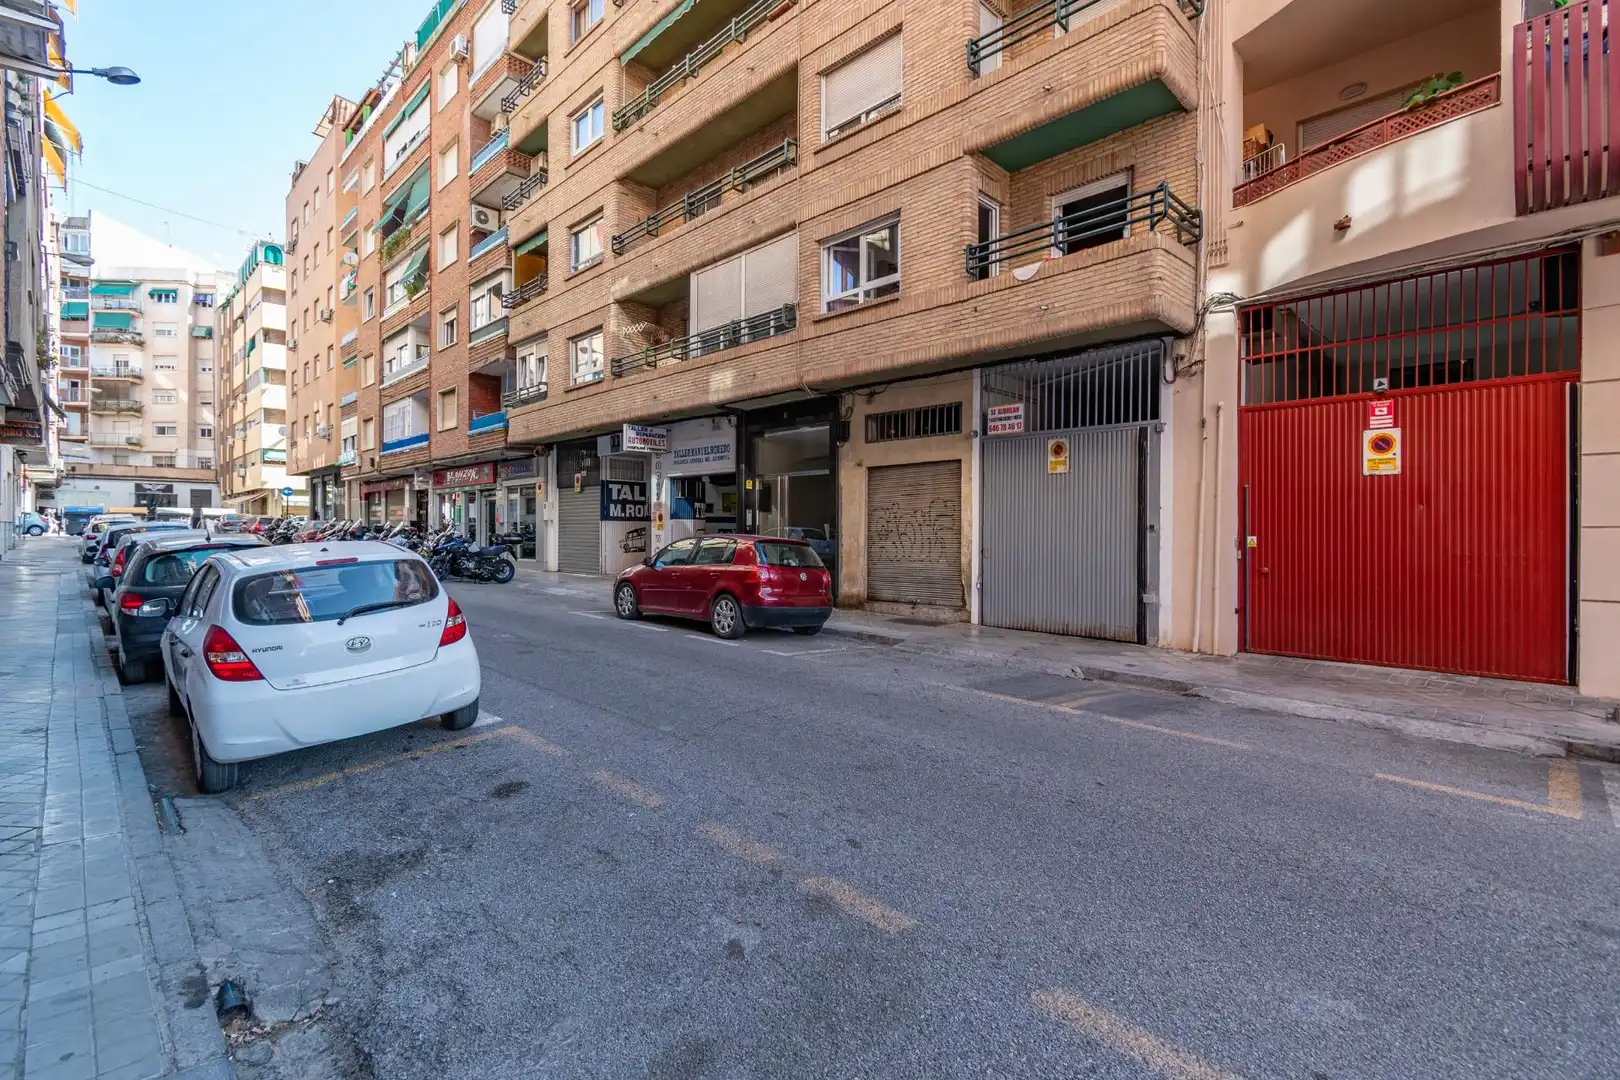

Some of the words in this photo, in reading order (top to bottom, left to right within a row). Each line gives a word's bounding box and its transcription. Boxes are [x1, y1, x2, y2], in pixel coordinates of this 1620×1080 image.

[628, 436, 666, 446] AUTOMOVILES
[609, 484, 646, 500] TAL
[252, 645, 283, 653] HYUNDAI
